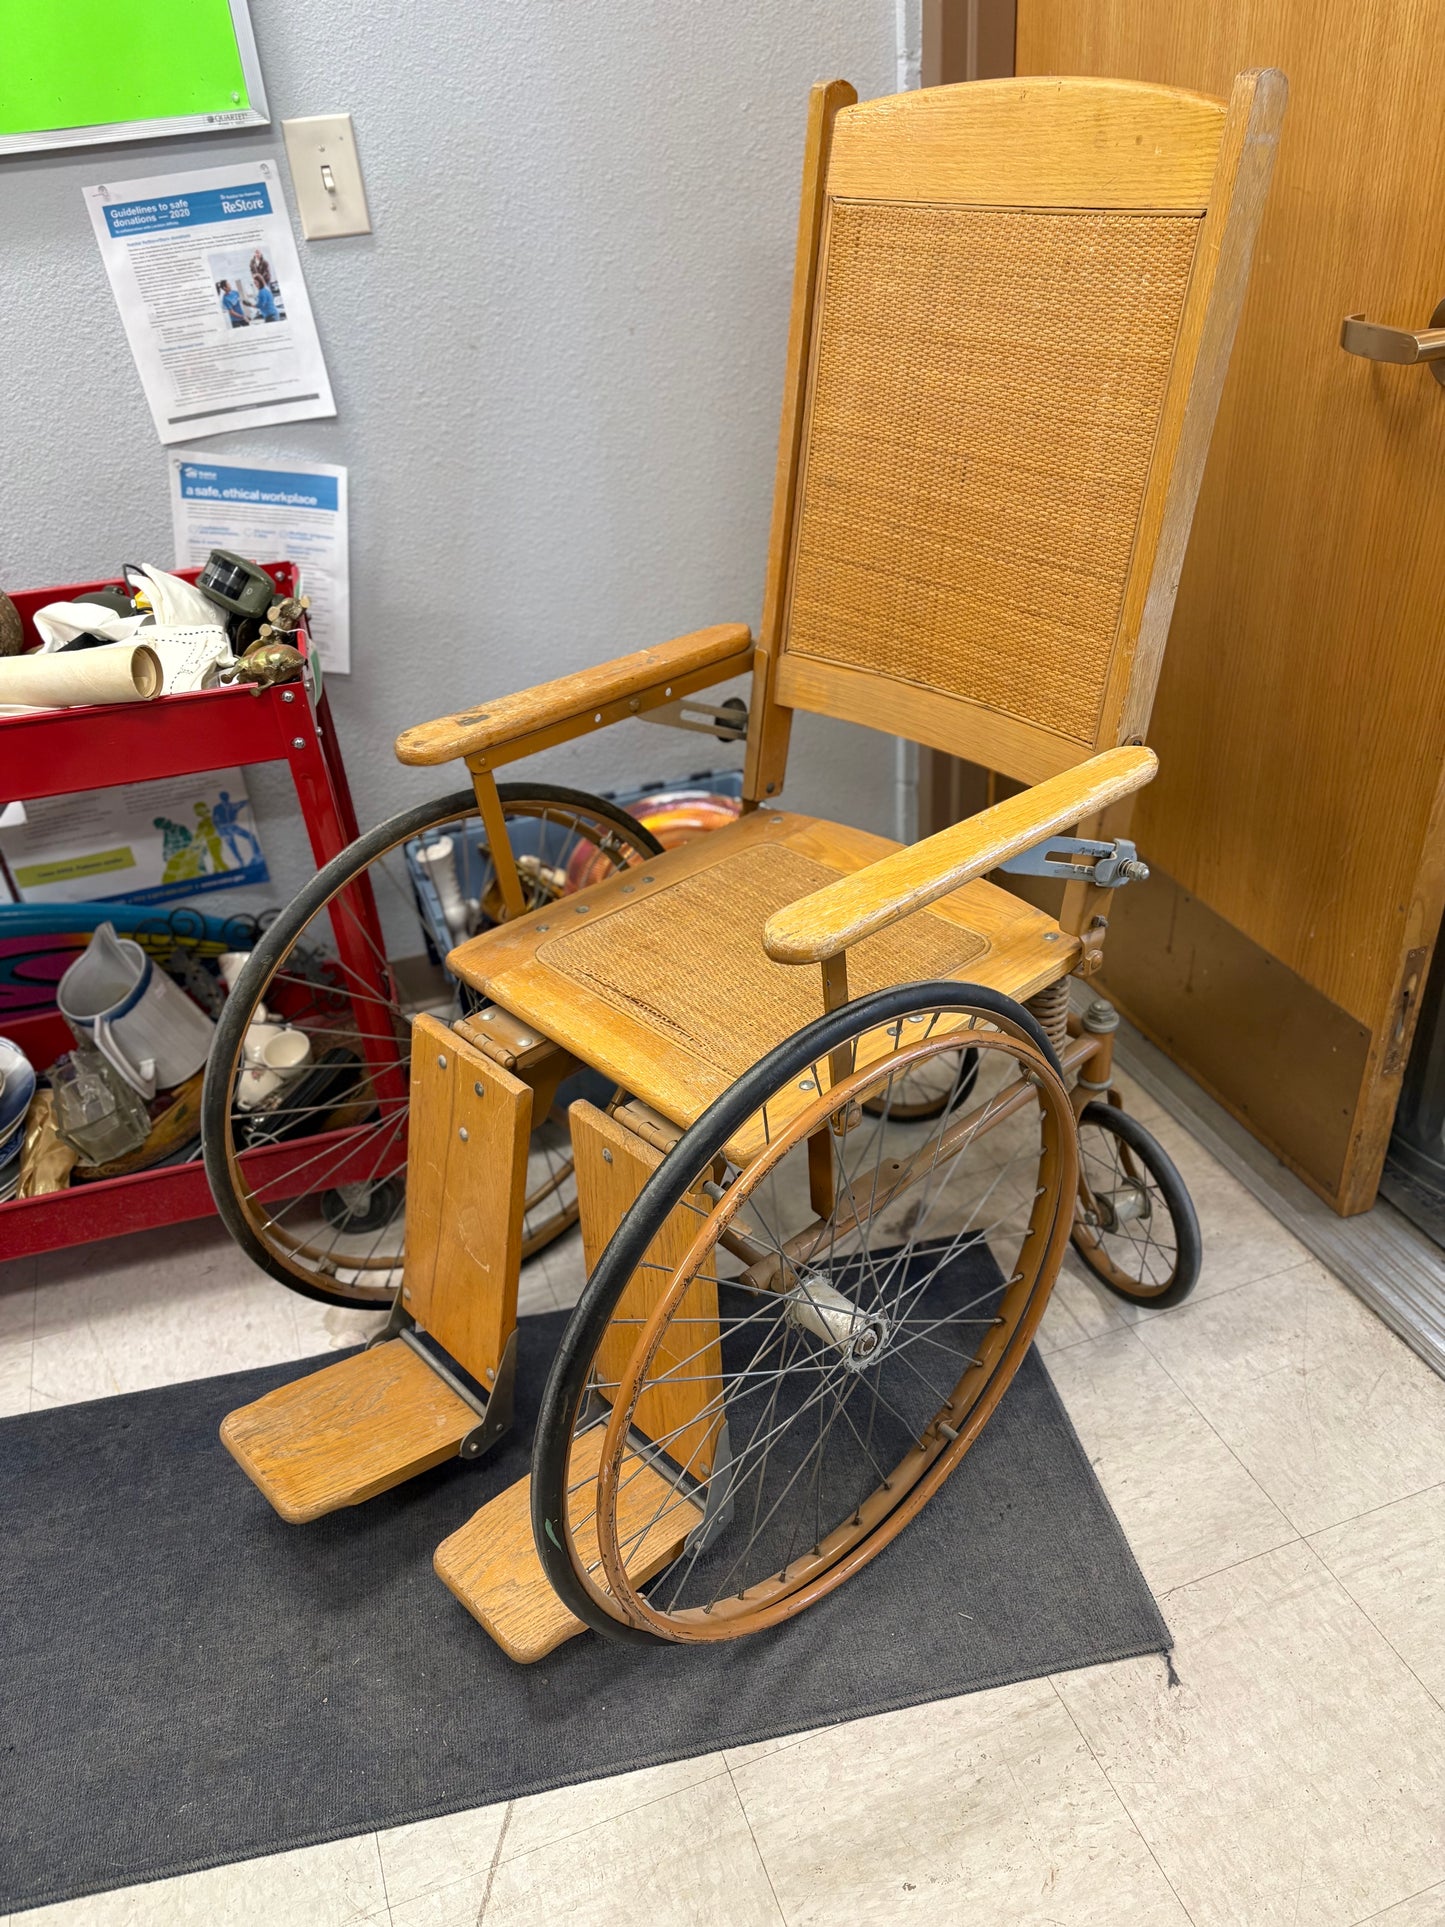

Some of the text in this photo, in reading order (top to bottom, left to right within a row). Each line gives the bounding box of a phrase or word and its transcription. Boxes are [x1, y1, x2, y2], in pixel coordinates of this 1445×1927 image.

[110, 199, 189, 219] Guidelines to safe
[222, 198, 264, 214] ReStore
[113, 214, 157, 228] donations
[169, 208, 190, 219] 2020
[186, 485, 318, 506] a safe, ethical workplace
